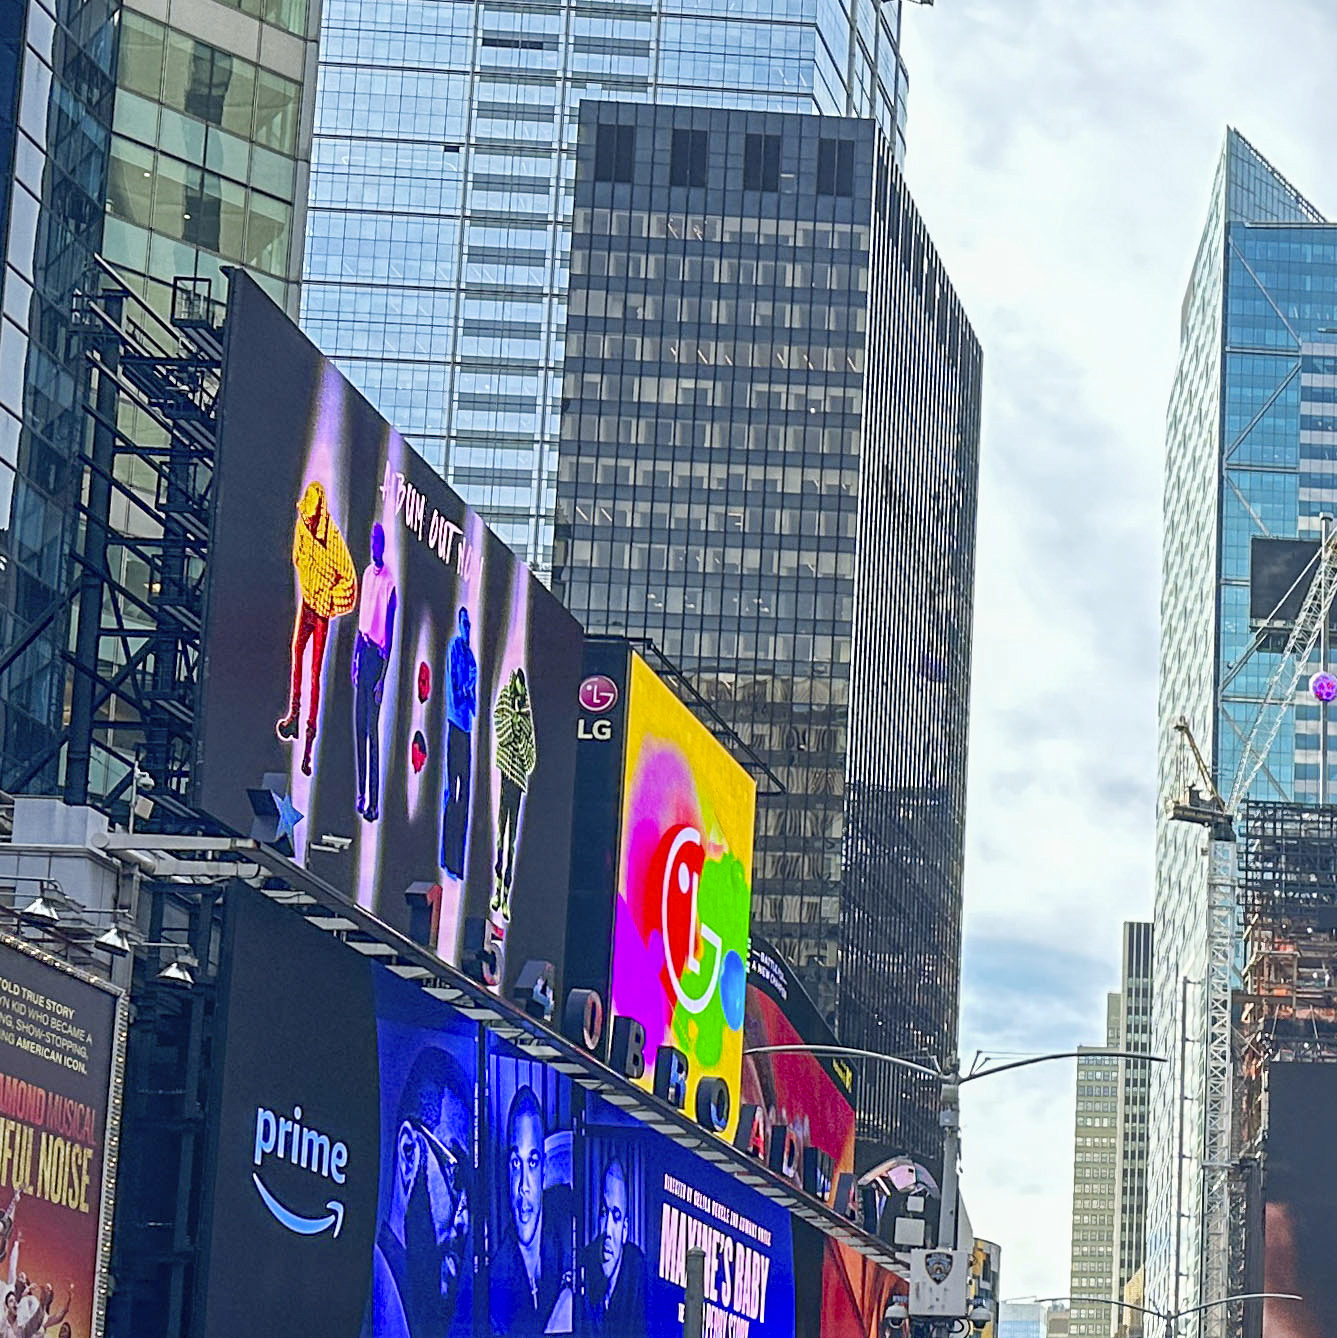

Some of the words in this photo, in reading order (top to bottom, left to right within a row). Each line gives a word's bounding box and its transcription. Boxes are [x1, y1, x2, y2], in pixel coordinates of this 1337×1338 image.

[380, 460, 426, 541] ABUM
[428, 508, 464, 565] OUT
[577, 718, 612, 740] LG
[21, 986, 45, 1008] TRUE
[46, 998, 76, 1020] STORY
[28, 1006, 49, 1026] WHO
[50, 1016, 86, 1042] BECAME
[16, 1036, 63, 1065] AMERICAN
[36, 1131, 94, 1214] NOISE
[254, 1105, 348, 1184] prime
[659, 1202, 734, 1308] MANE'S
[733, 1241, 770, 1324] BABY
